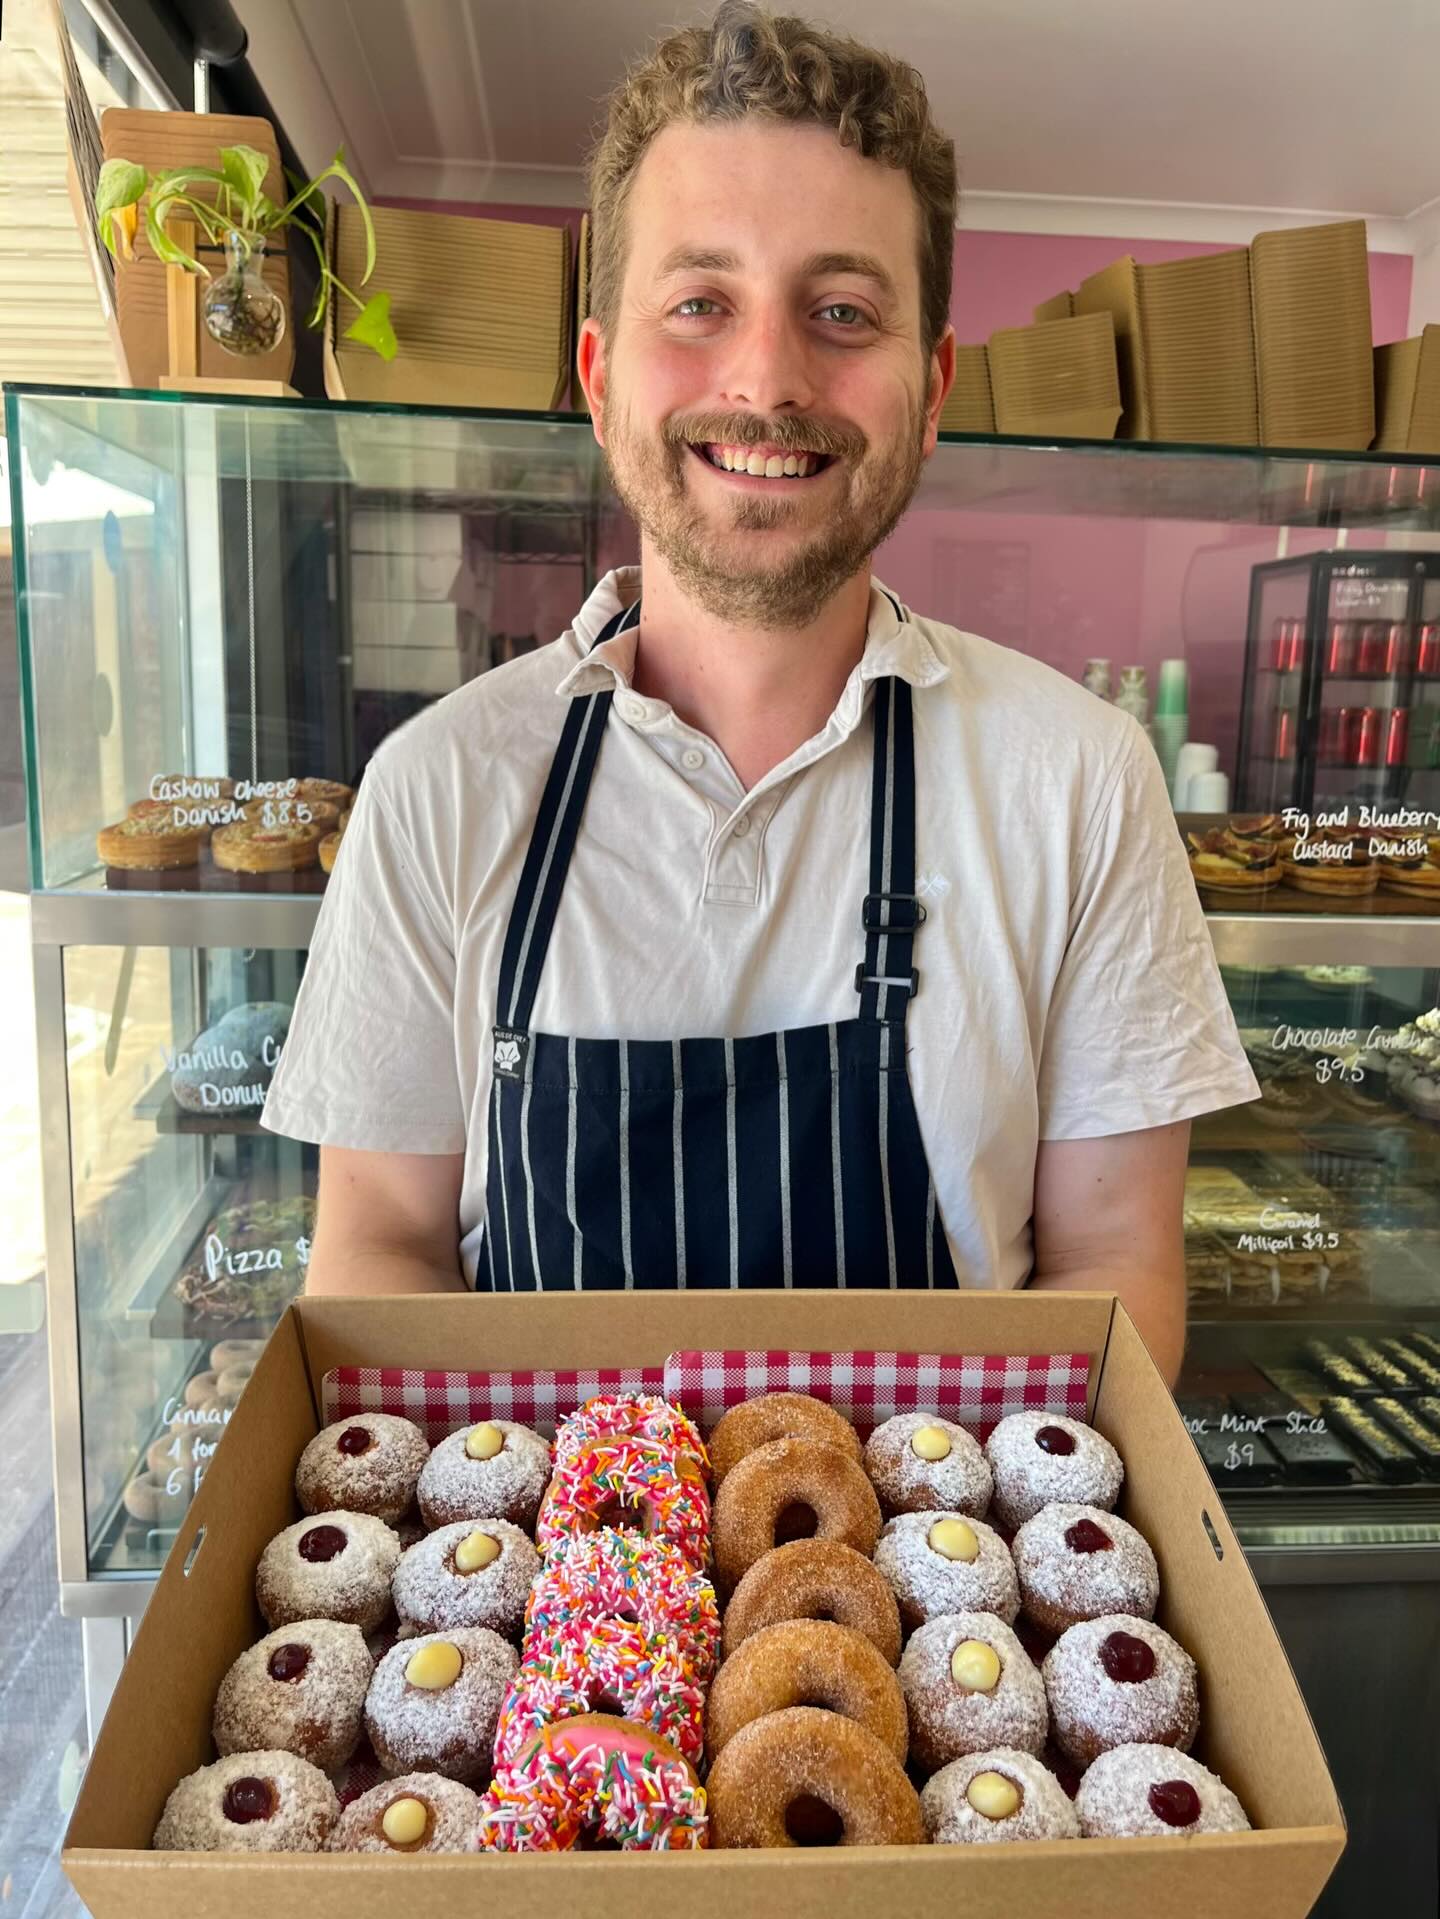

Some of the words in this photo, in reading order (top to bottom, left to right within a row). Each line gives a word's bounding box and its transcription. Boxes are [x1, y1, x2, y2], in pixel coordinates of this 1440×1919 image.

[174, 801, 247, 827] Danish
[262, 801, 313, 829] $8.5
[1281, 807, 1309, 840] Fig
[1316, 805, 1348, 828] and
[1293, 839, 1353, 860] Custard
[1368, 837, 1429, 857] Danish
[1271, 1024, 1357, 1050] Chocolate
[160, 1045, 248, 1072] Vanilla
[1315, 1056, 1367, 1084] $9.5
[1260, 1207, 1320, 1230] Caramel
[1301, 1231, 1338, 1250] $9.5
[205, 1234, 283, 1282] Pizza
[1220, 1413, 1270, 1433] Mint
[1286, 1410, 1329, 1434] Slice
[1224, 1441, 1254, 1471] $9
[166, 1467, 183, 1496] 6
